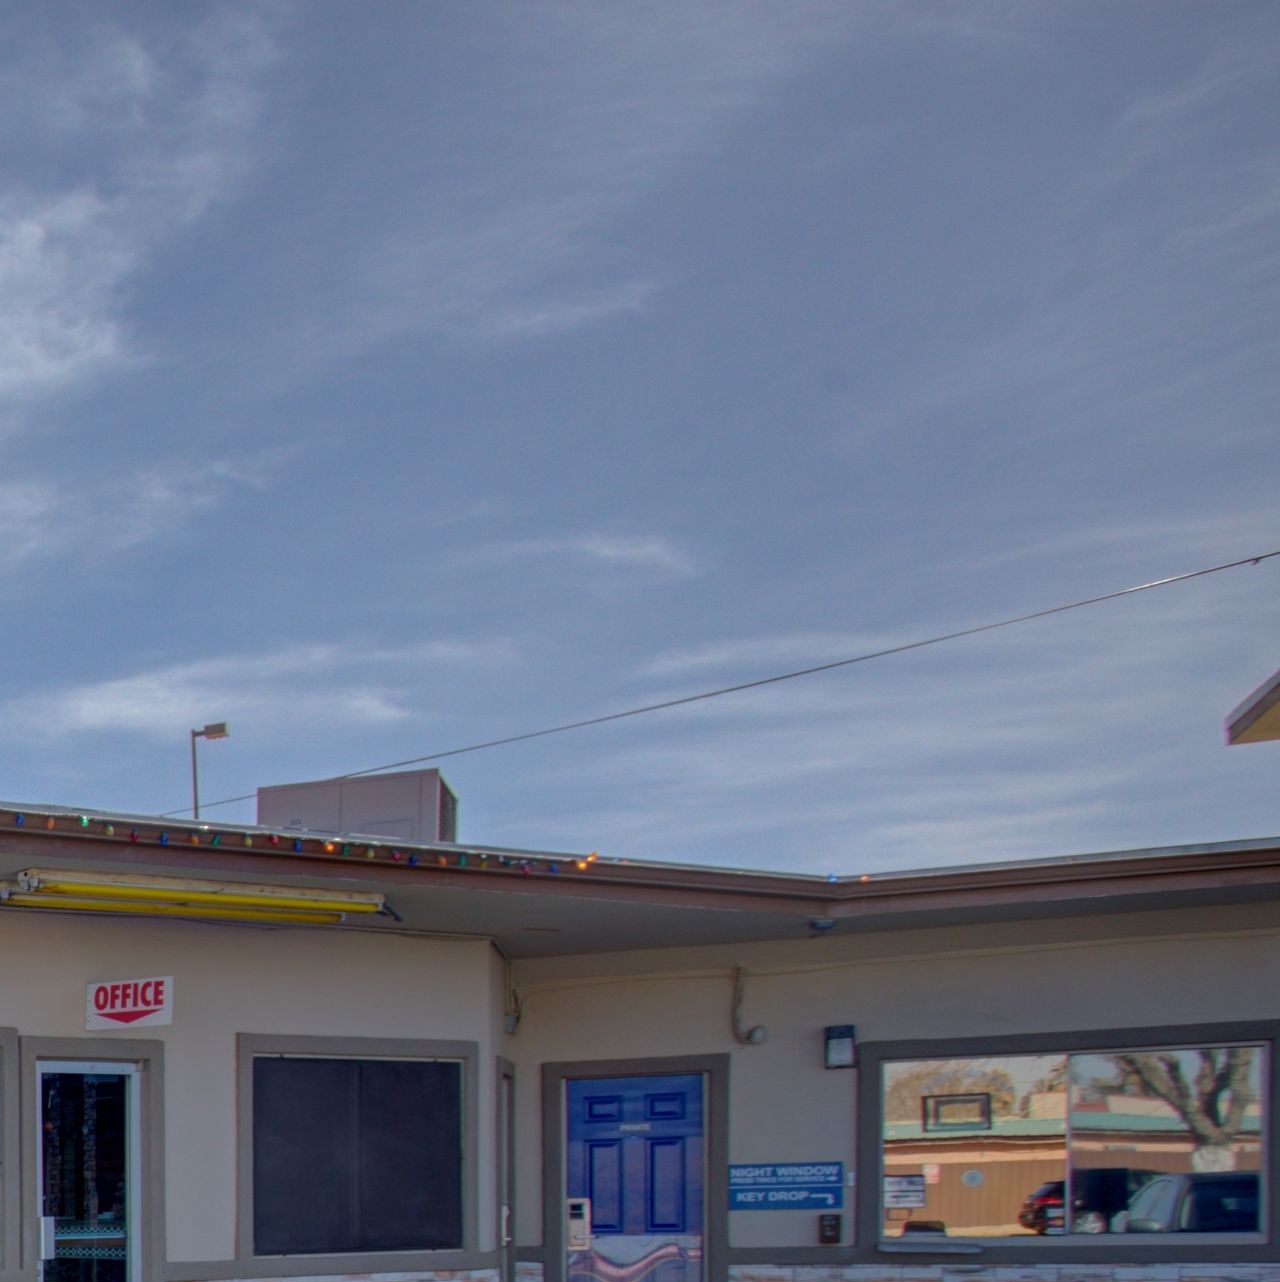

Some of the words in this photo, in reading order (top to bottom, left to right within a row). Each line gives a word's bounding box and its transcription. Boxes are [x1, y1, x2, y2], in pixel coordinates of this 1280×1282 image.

[94, 980, 164, 1011] OFFICE
[730, 1167, 774, 1177] NIGHT
[775, 1165, 839, 1176] WINDOW
[736, 1192, 766, 1202] KEY
[768, 1191, 809, 1201] DROP
